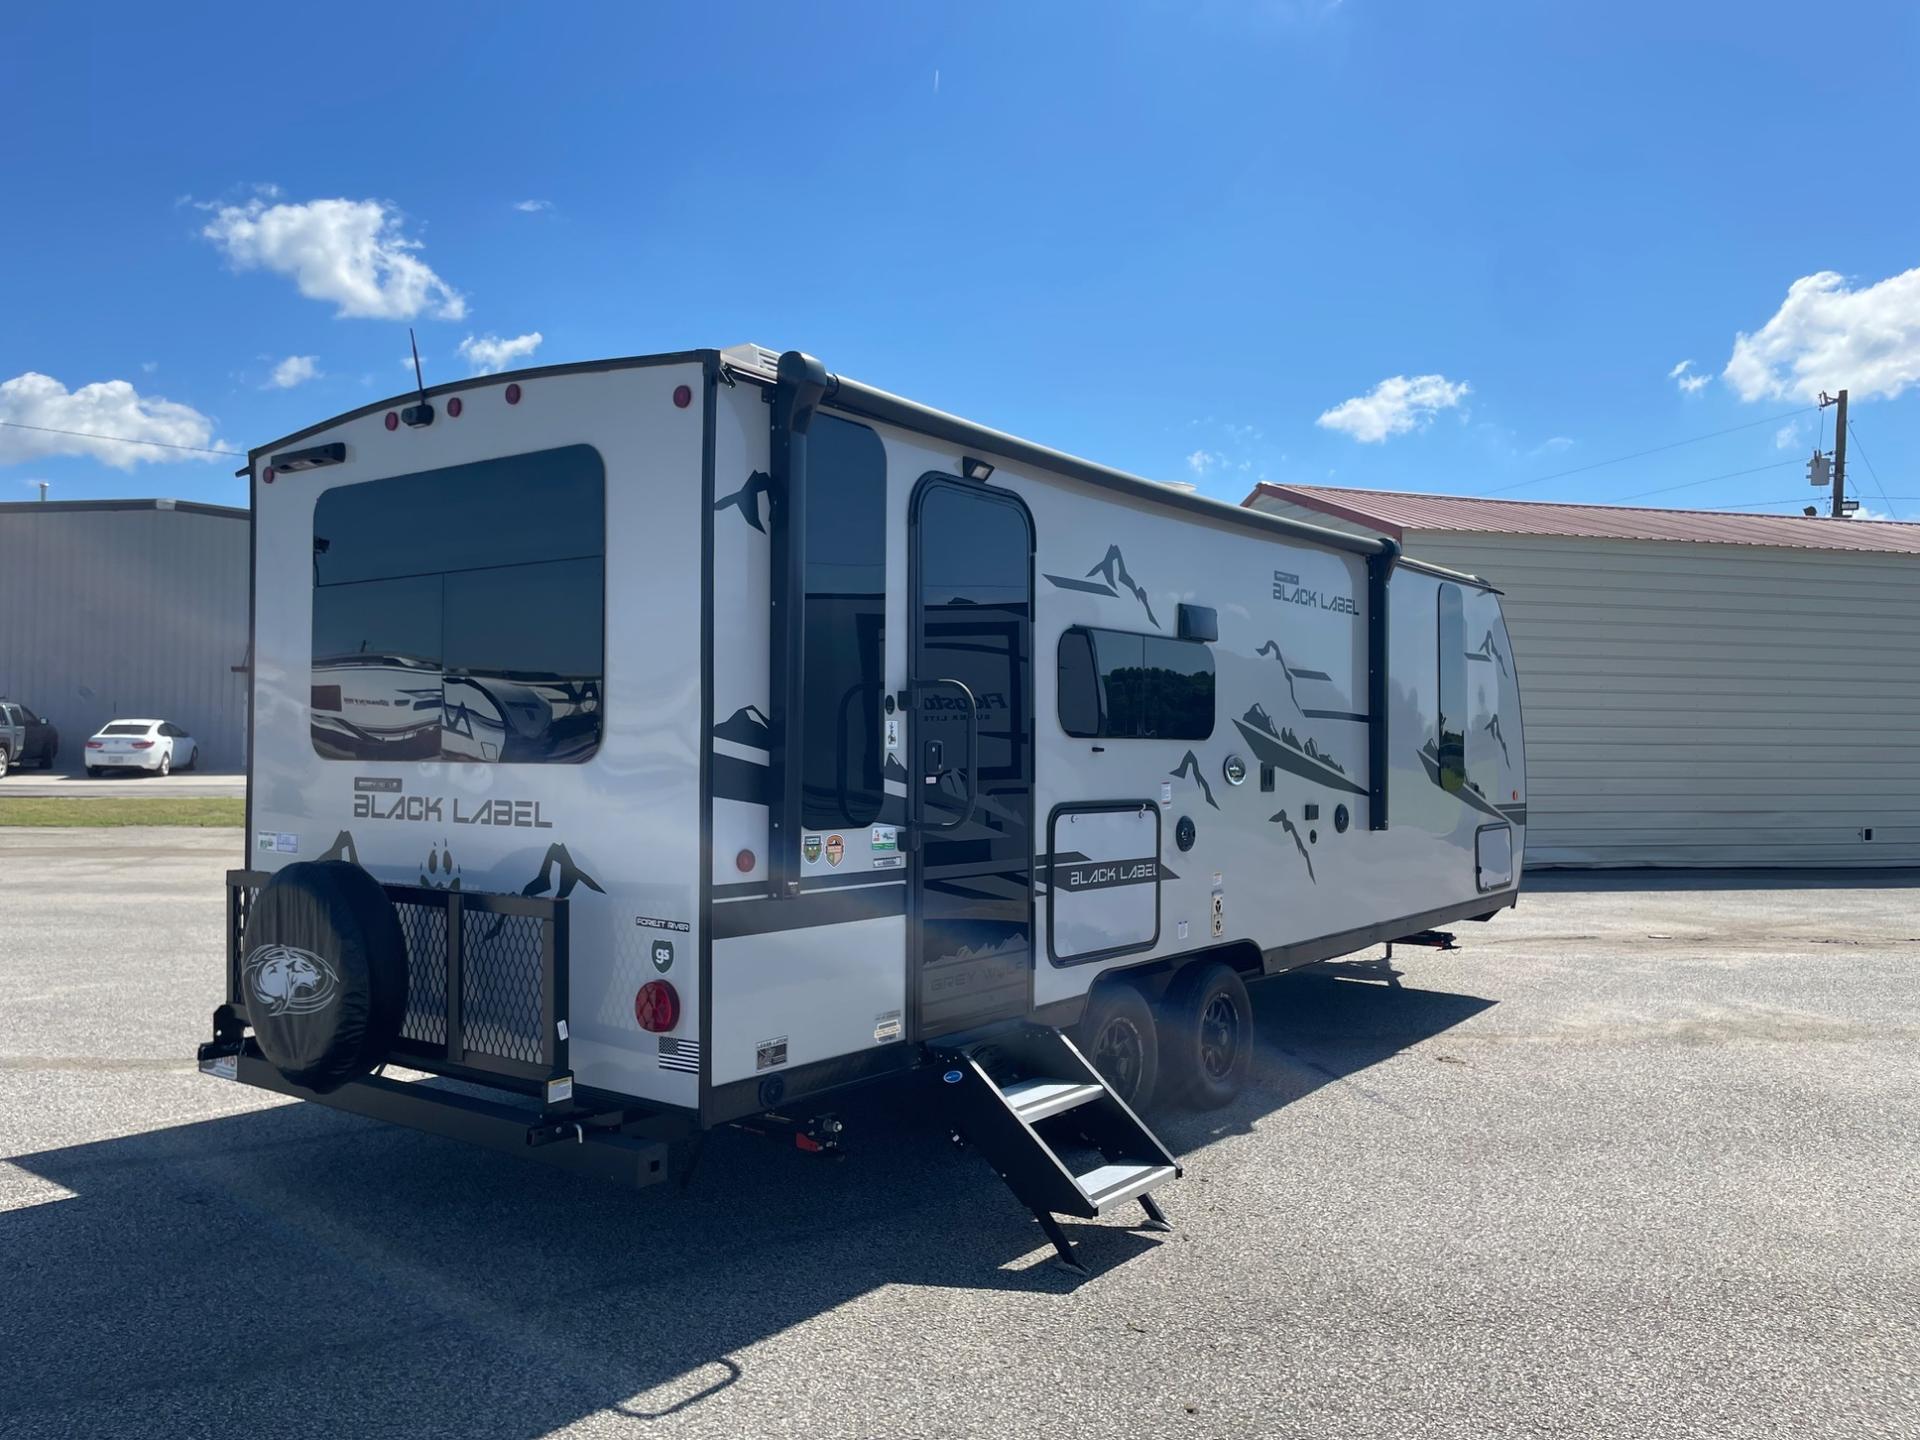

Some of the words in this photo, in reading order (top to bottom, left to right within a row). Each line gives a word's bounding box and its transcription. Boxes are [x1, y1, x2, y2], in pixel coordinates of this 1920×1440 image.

[1272, 582, 1317, 608] BLACK
[1320, 592, 1360, 616] LABEL
[353, 794, 444, 822] BLACK
[453, 798, 553, 829] LABEL
[1070, 867, 1116, 885] BLACK
[1120, 863, 1157, 880] LABEL
[667, 921, 689, 931] RIVER
[655, 948, 670, 964] gs
